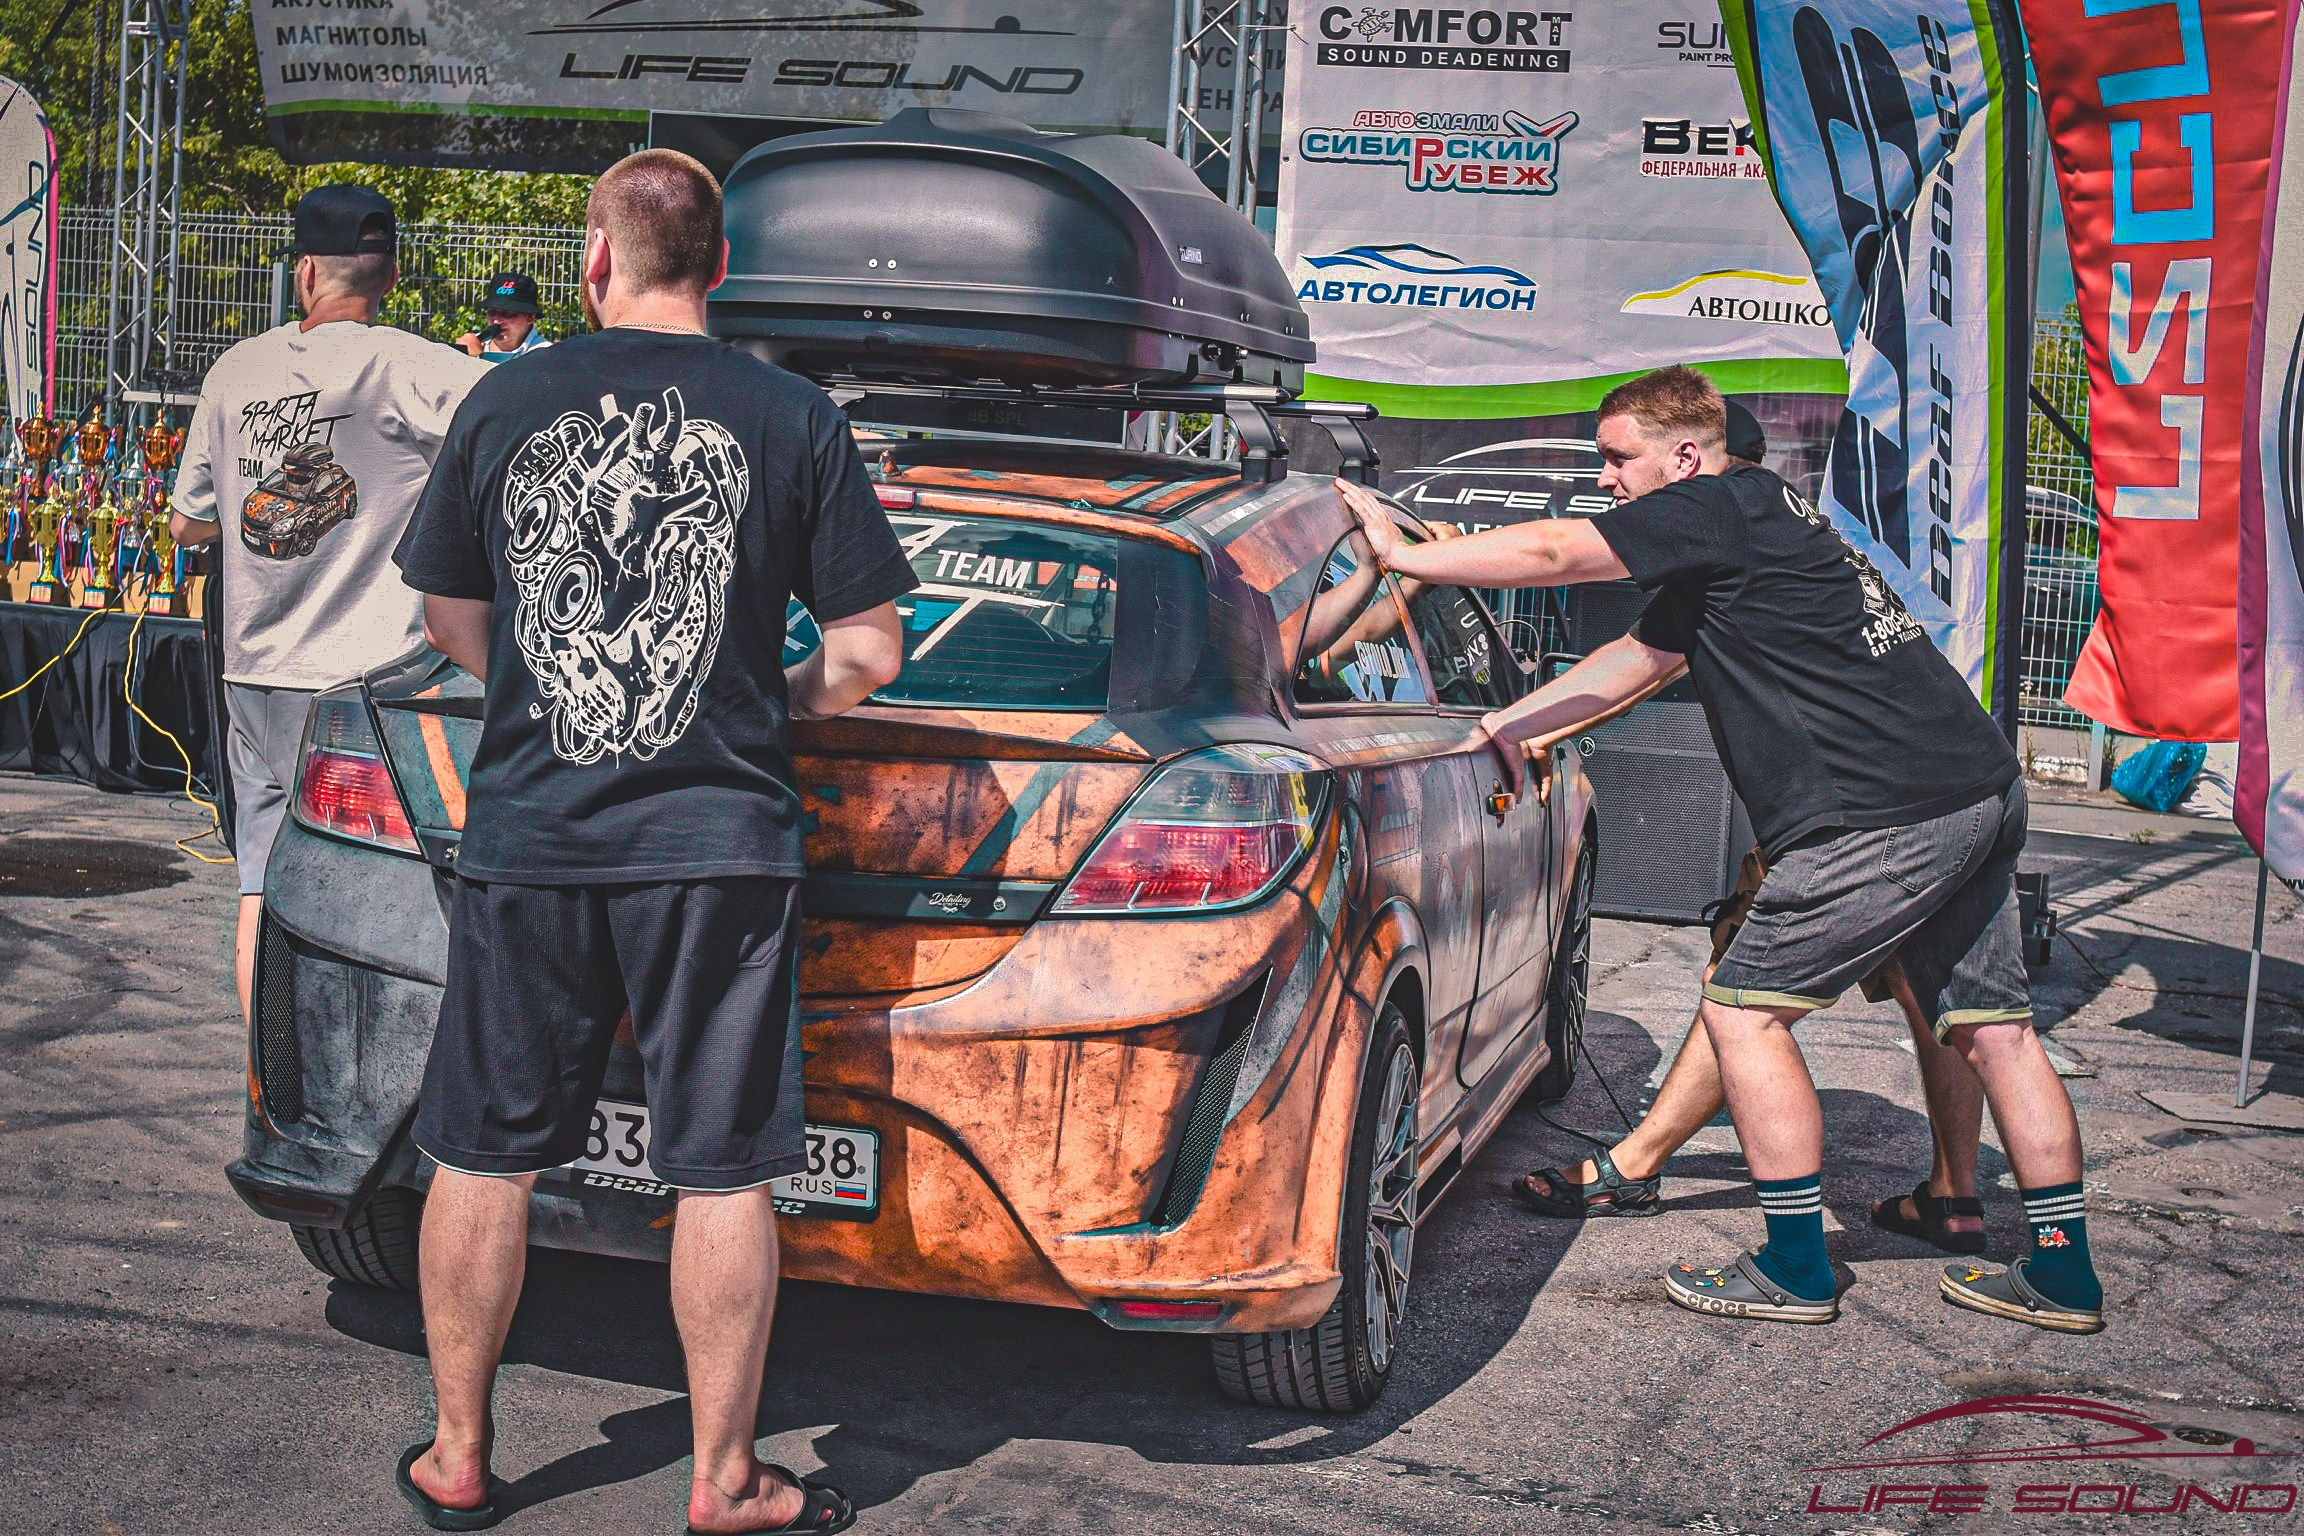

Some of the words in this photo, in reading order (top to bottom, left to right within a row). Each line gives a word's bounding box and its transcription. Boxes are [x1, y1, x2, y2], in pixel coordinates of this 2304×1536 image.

[276, 26, 428, 46] МАГНИТОЛЫ
[1327, 48, 1407, 64] SOUND
[1421, 52, 1559, 68] DEADENING
[1679, 52, 1712, 62] PAINT
[280, 62, 488, 88] ШУМОИЗОЛЯЦИЯ
[559, 52, 752, 84] LIFE
[772, 59, 1085, 95] SOUND
[1353, 110, 1499, 132] АВТОЭМАЛИ
[1642, 160, 1737, 177] ФЕДЕРАЛЬНАЯ
[25, 160, 45, 372] SOUND
[1297, 280, 1537, 312] АВТОЛЕГИОН
[239, 389, 324, 434] SPARTA
[250, 413, 357, 458] MARKET
[238, 457, 264, 480] TEAM
[1413, 485, 1552, 510] LIFE
[935, 549, 1032, 589] TEAM
[1870, 639, 1892, 658] GET
[791, 1176, 833, 1196] RUS
[1687, 1293, 1747, 1316] crocs
